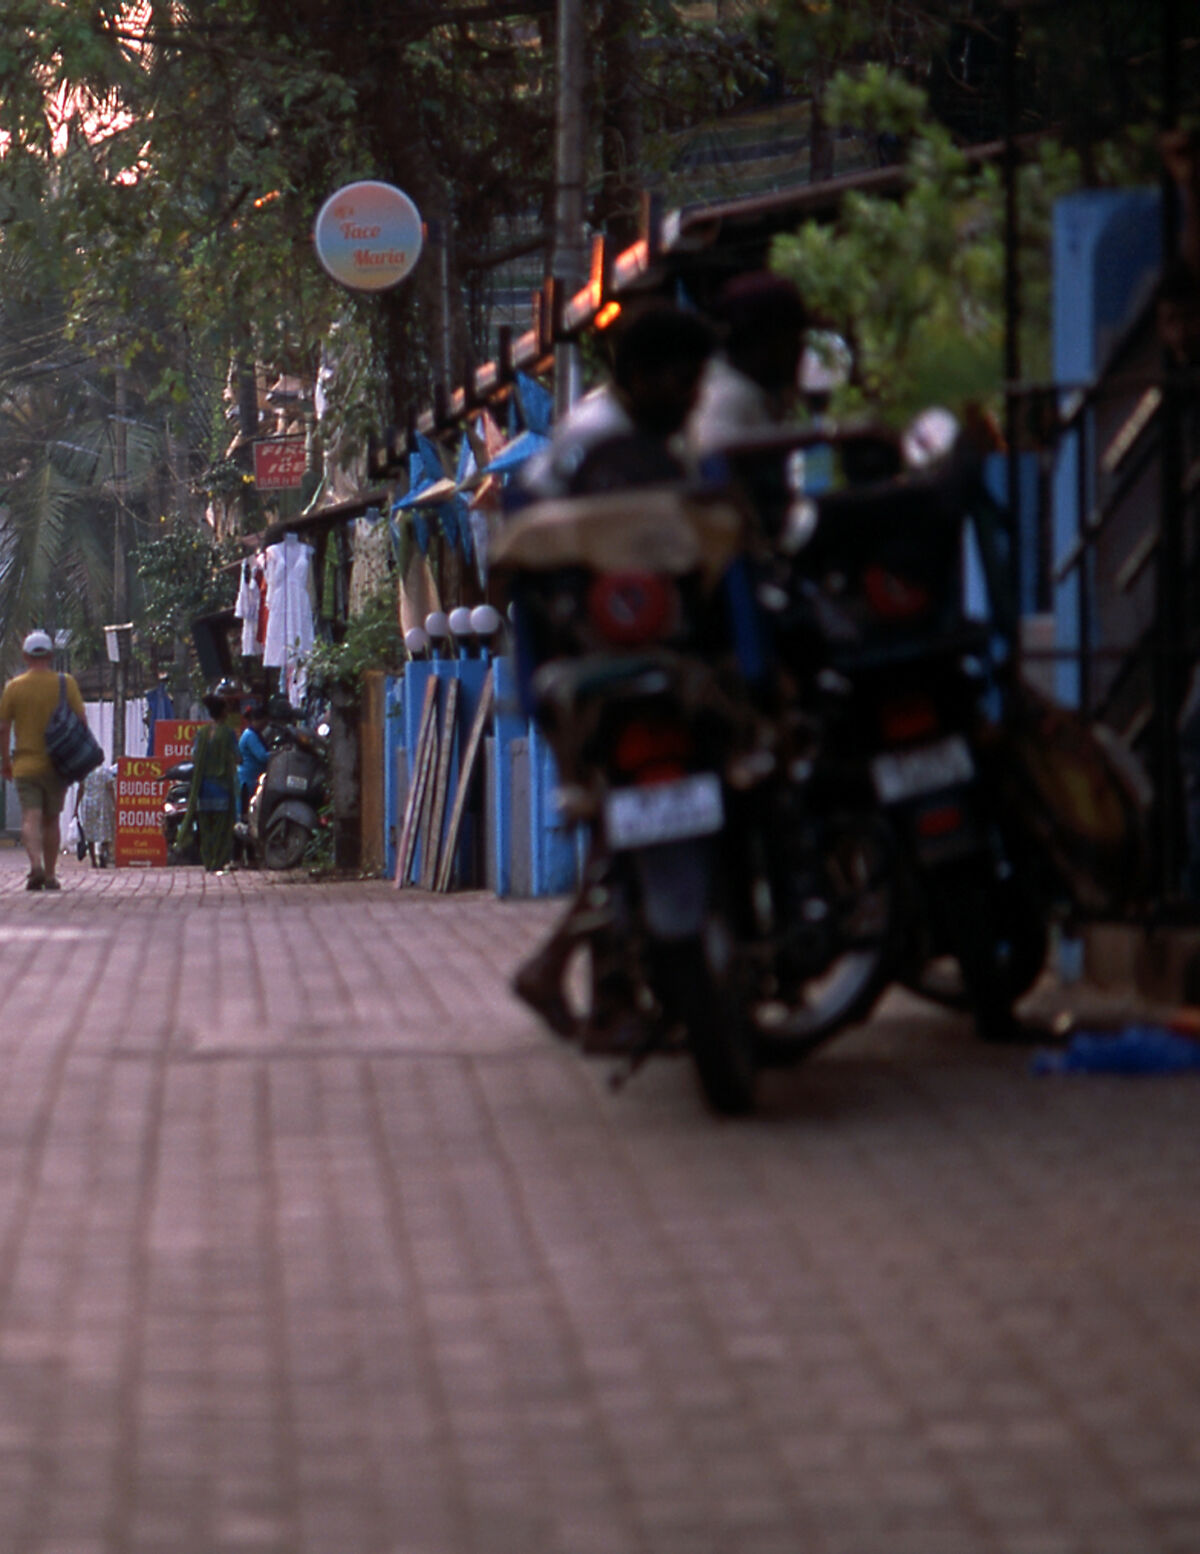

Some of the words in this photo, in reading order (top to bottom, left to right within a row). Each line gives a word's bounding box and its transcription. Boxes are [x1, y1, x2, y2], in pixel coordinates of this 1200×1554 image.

[354, 248, 405, 265] Maria
[164, 744, 194, 757] BUD
[123, 761, 162, 777] JC'S
[119, 781, 165, 796] BUDGET
[118, 810, 166, 827] ROOMS
